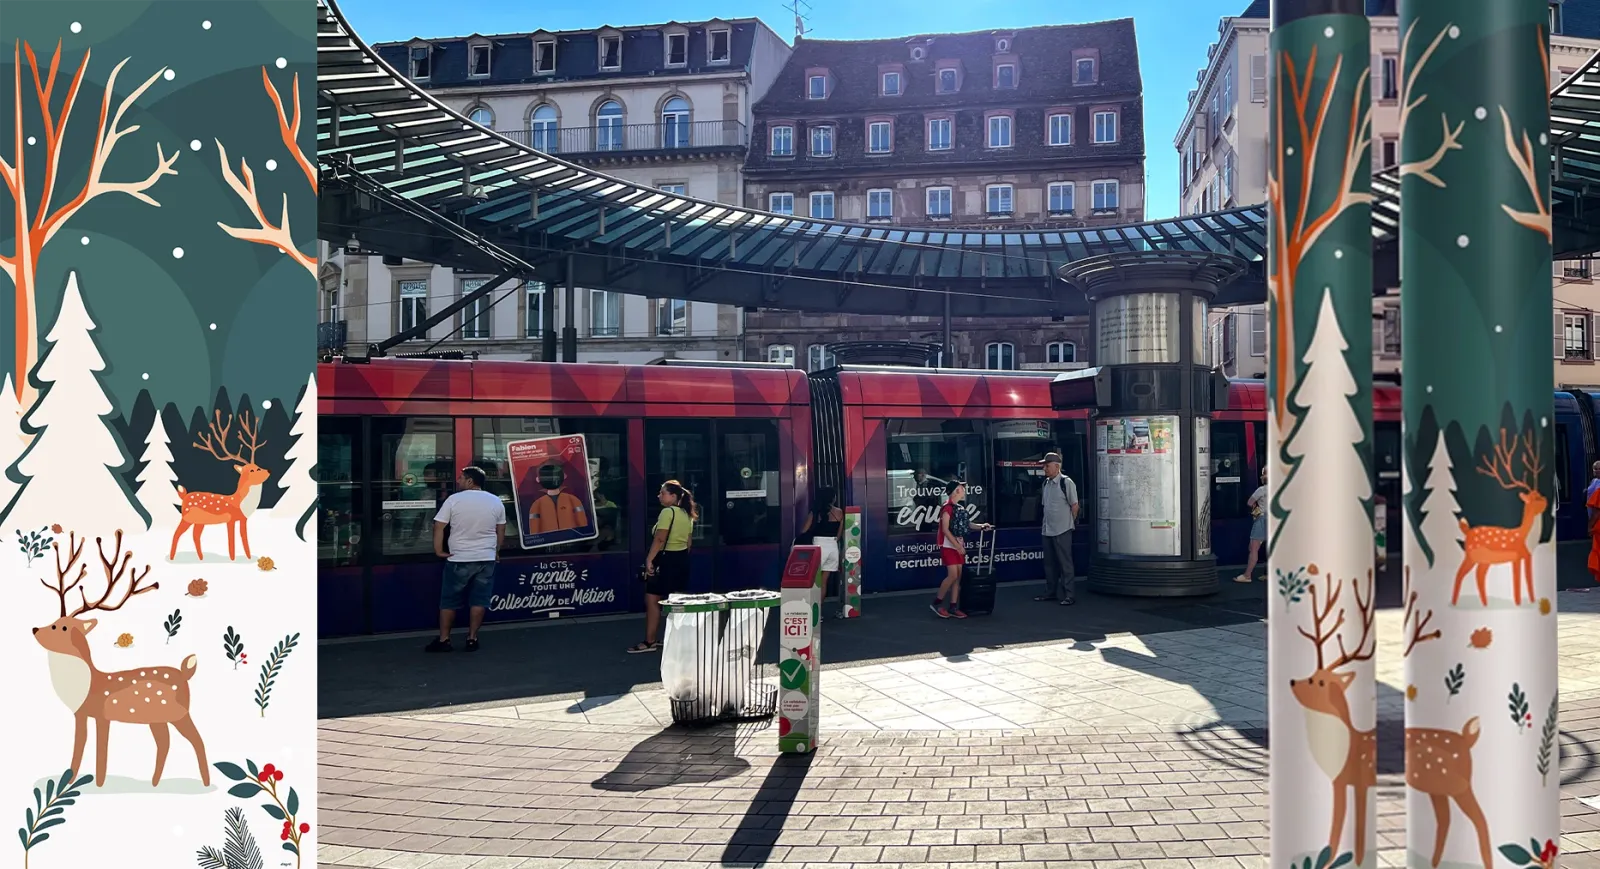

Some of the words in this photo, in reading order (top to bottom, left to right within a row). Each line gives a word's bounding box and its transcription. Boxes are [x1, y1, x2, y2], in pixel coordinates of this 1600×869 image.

[512, 444, 536, 452] Fabien
[896, 485, 947, 498] Trouvez
[895, 543, 905, 553] et
[540, 562, 548, 570] la
[550, 561, 568, 569] CTS
[530, 567, 578, 584] recrute
[488, 591, 556, 612] Collection
[558, 598, 570, 606] DE
[571, 587, 615, 606] Métiers
[784, 617, 807, 625] C'EST
[784, 625, 800, 636] ICI
